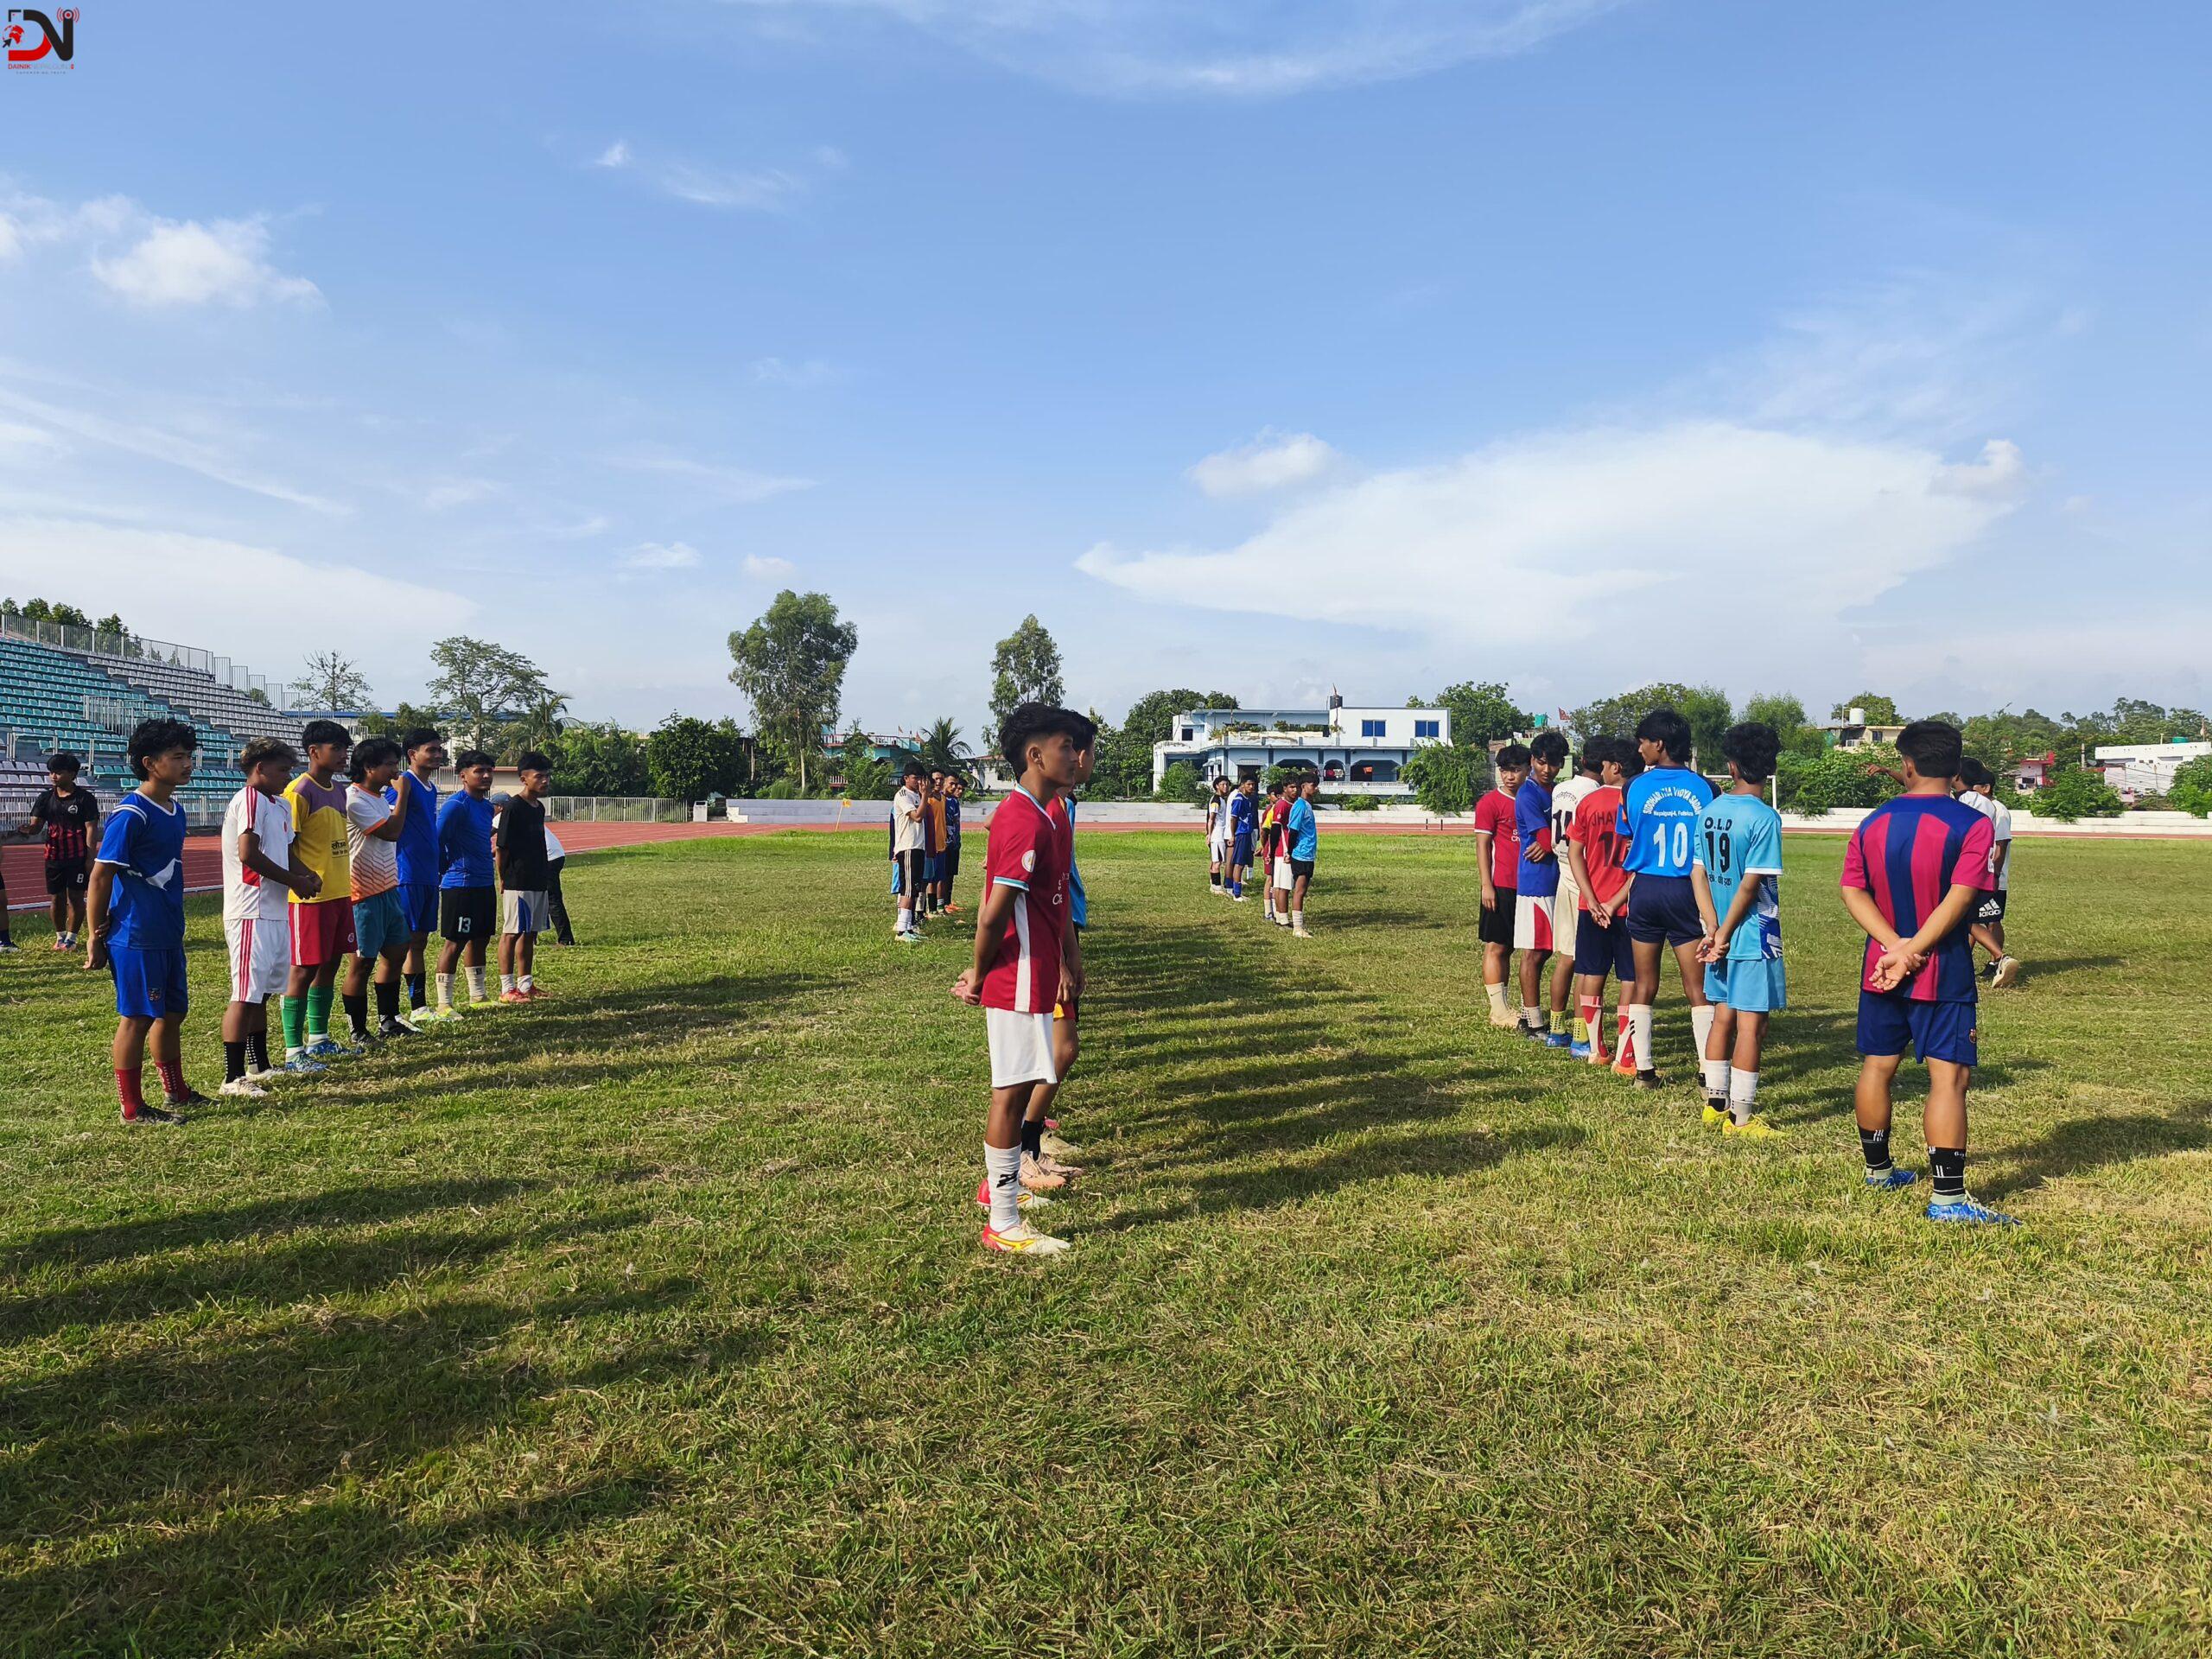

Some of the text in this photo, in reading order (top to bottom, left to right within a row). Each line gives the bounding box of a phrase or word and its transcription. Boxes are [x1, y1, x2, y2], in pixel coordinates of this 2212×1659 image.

[1592, 810, 1618, 827] JHA
[1653, 822, 1688, 868] 10
[1705, 831, 1731, 873] 19
[77, 873, 84, 884] 8
[457, 917, 472, 933] 13
